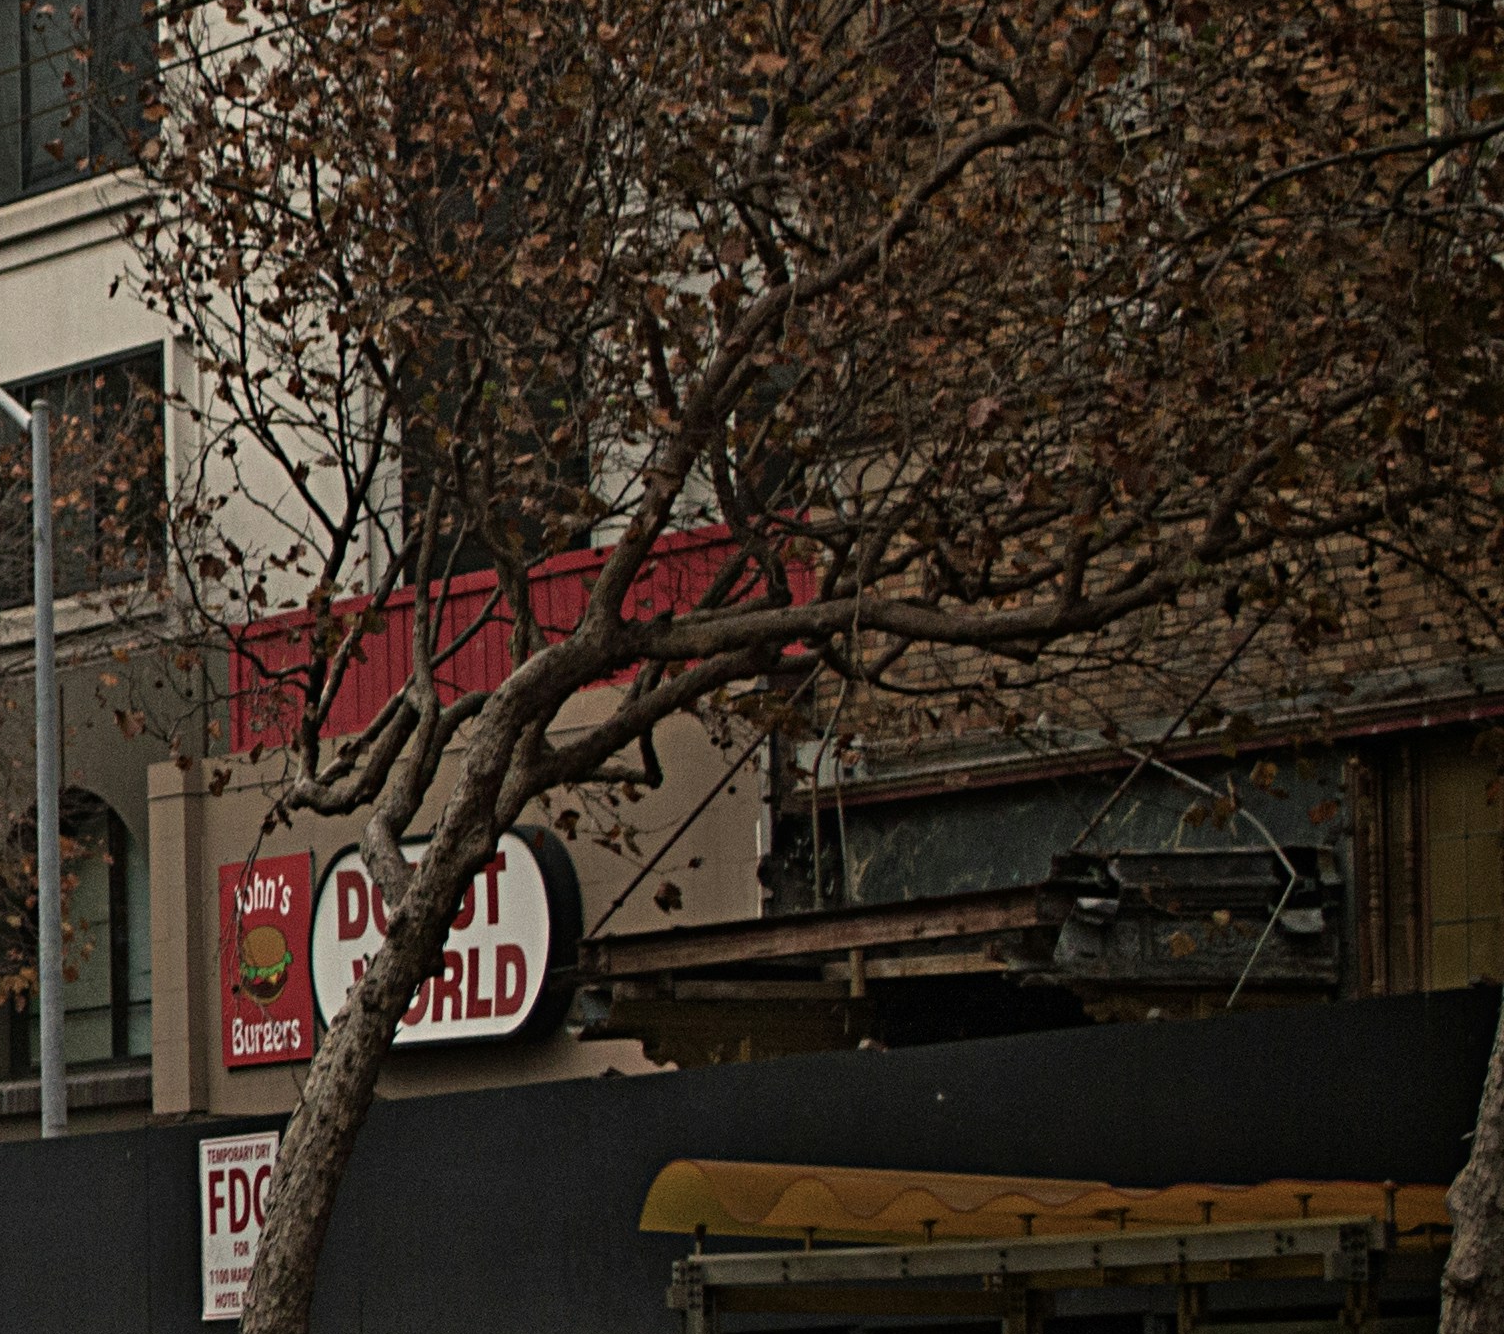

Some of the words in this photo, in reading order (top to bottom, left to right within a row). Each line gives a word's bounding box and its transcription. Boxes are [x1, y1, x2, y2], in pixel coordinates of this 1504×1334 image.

[351, 943, 528, 1027] ORLD
[231, 1017, 302, 1056] Burgers
[207, 1144, 254, 1165] TEMPORARY
[255, 1142, 272, 1160] DRY
[233, 1240, 250, 1258] FOR
[208, 1268, 230, 1285] 1100
[214, 1292, 241, 1310] HOTEL
